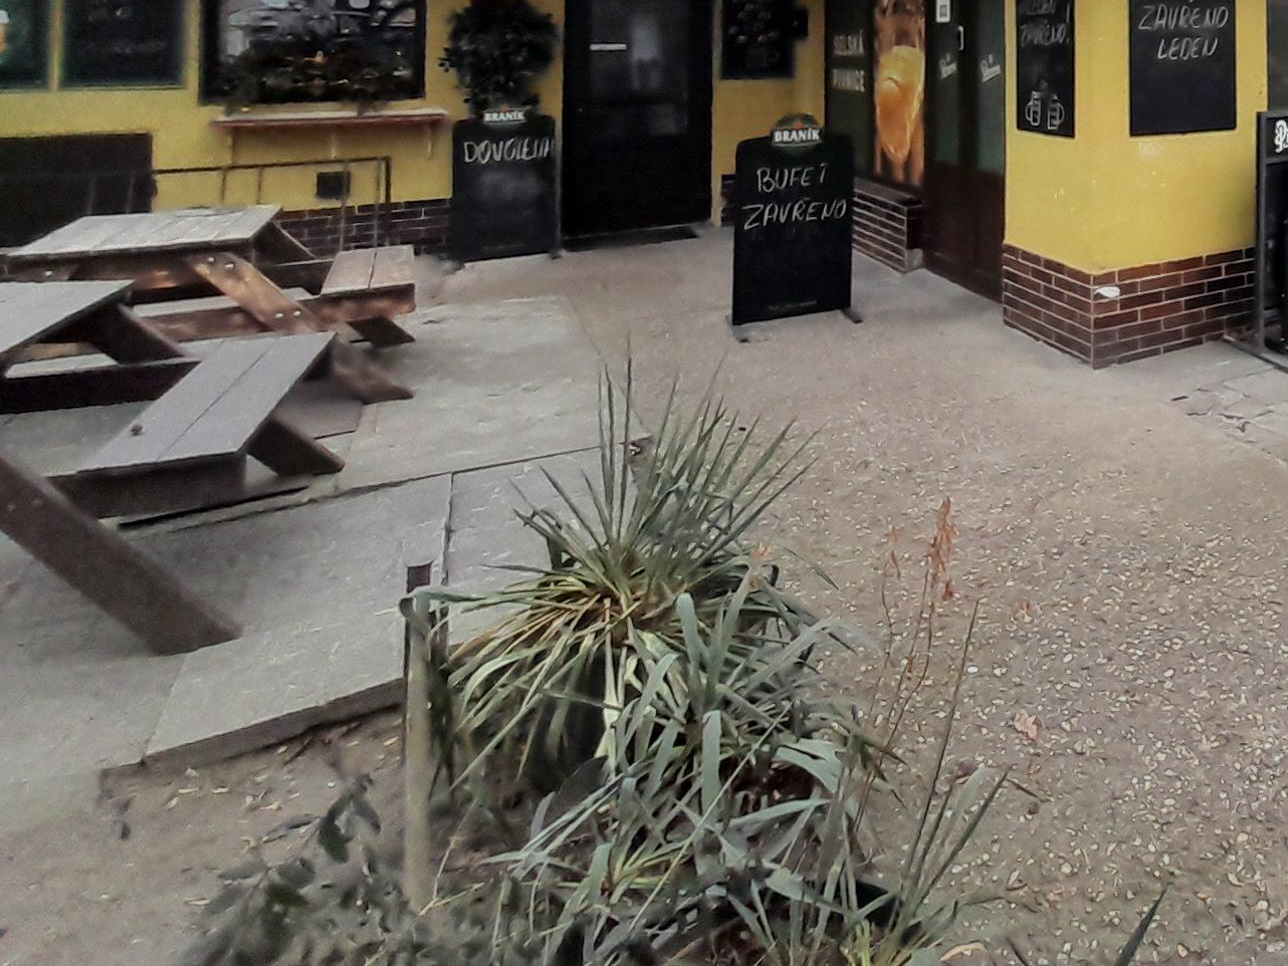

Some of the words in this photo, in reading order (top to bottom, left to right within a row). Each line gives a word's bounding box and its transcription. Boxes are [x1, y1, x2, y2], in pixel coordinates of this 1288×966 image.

[1158, 37, 1218, 60] LEDEN
[774, 127, 821, 143] BRANÍK
[757, 162, 829, 193] BUFET
